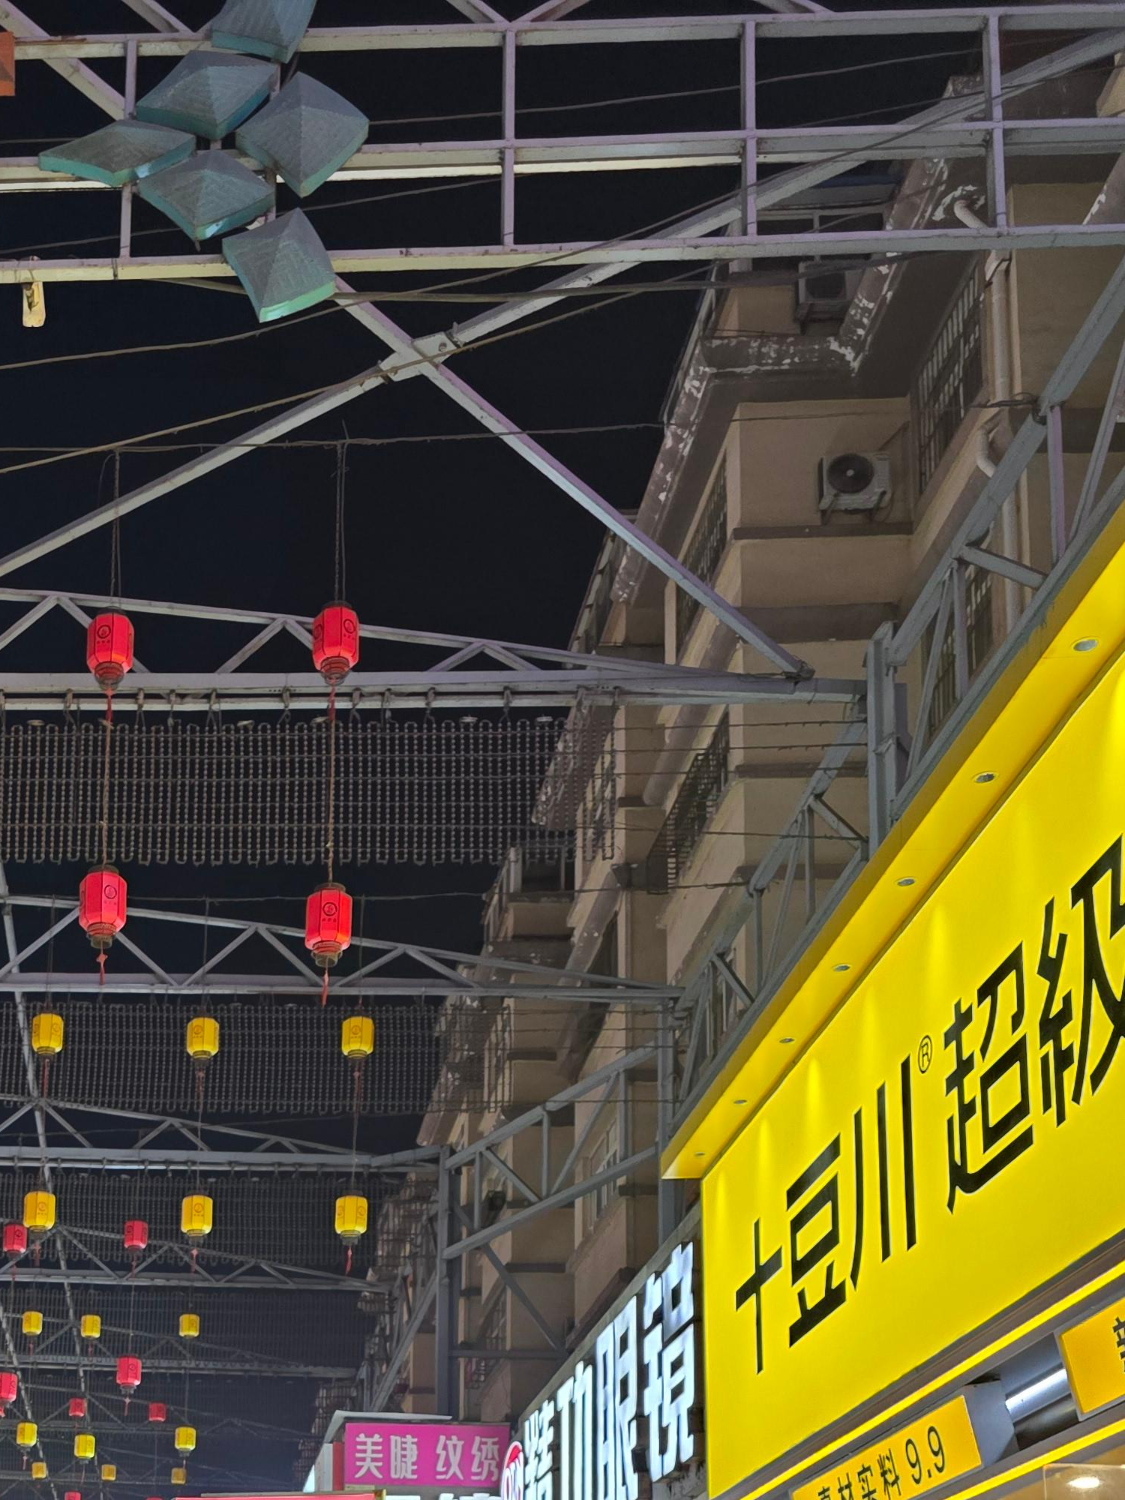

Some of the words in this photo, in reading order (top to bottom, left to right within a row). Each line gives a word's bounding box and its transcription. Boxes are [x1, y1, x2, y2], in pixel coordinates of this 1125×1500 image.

[354, 1433, 418, 1480] 美睫
[435, 1435, 500, 1481] 纹绣
[905, 1426, 946, 1485] 9.9
